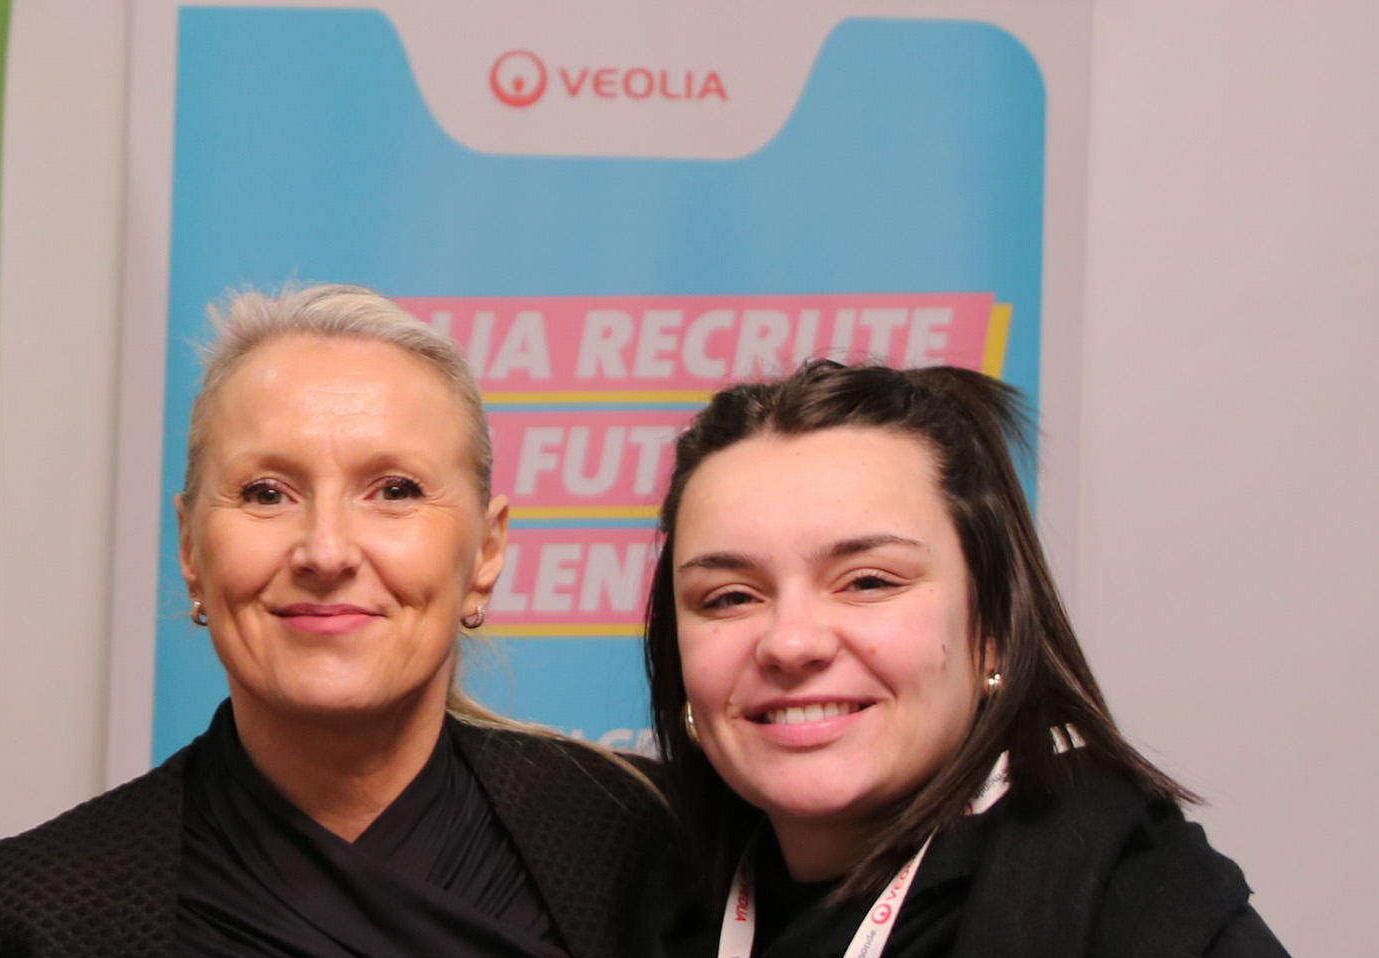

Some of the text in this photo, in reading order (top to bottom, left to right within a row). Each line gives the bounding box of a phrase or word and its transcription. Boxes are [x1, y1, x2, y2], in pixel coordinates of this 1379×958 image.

[559, 66, 728, 101] VEOLIA
[576, 307, 953, 379] RECRUTE
[514, 426, 680, 496] FUT
